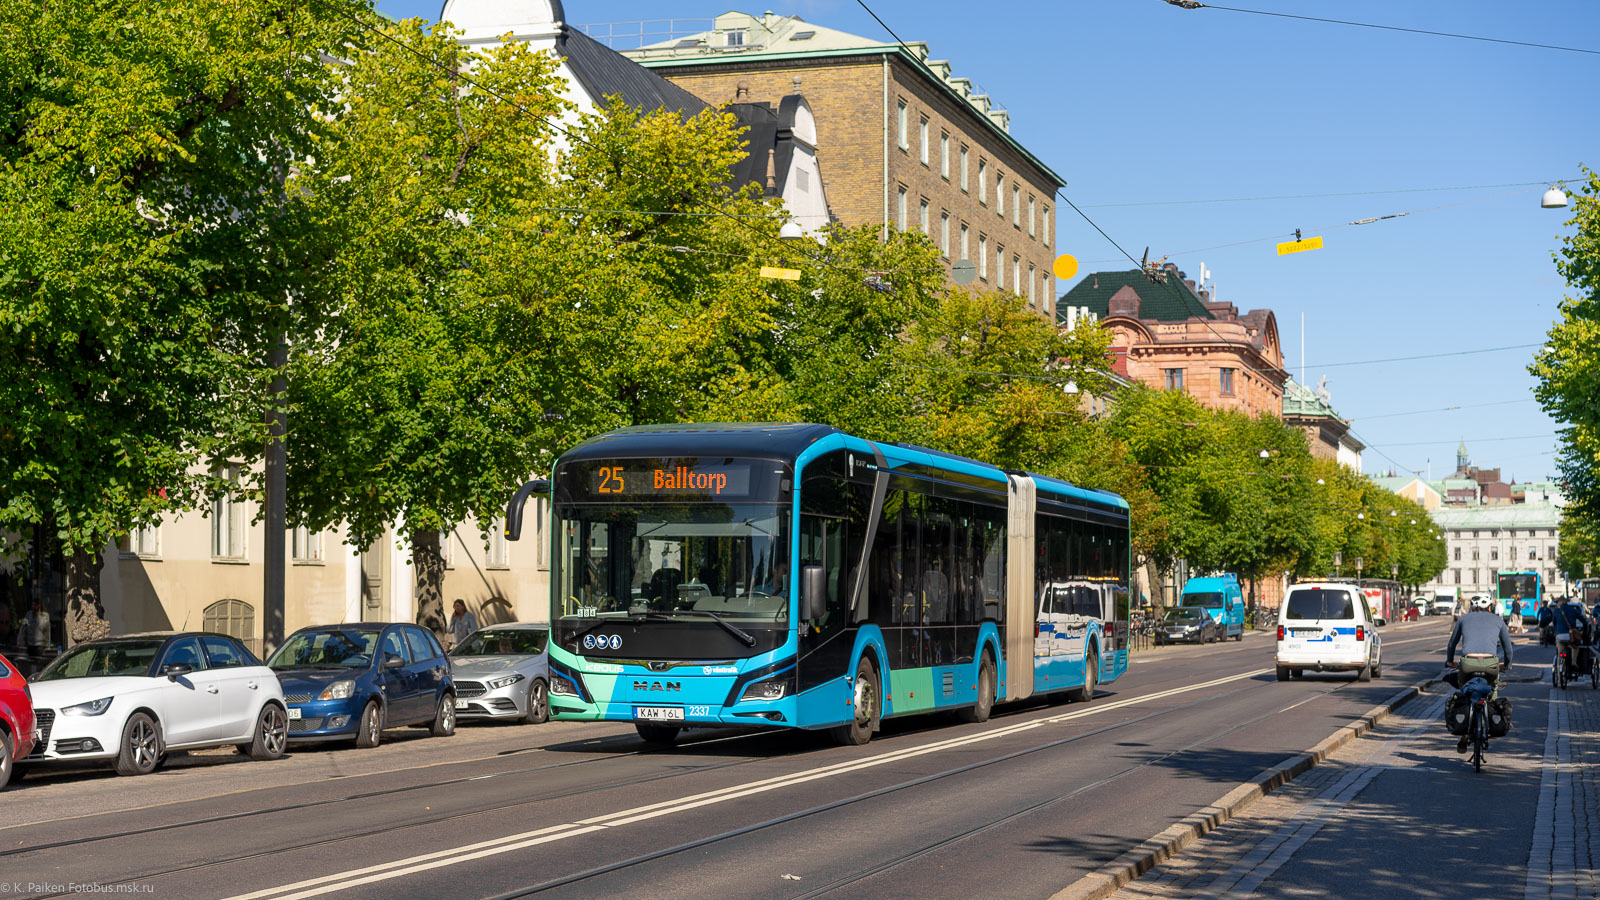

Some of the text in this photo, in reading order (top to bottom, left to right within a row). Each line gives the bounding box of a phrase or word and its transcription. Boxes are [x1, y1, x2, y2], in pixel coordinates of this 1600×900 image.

[598, 466, 727, 494] 25 Balltorp
[633, 680, 682, 692] MAN
[640, 707, 680, 719] KAW 16L
[689, 705, 710, 717] 2337
